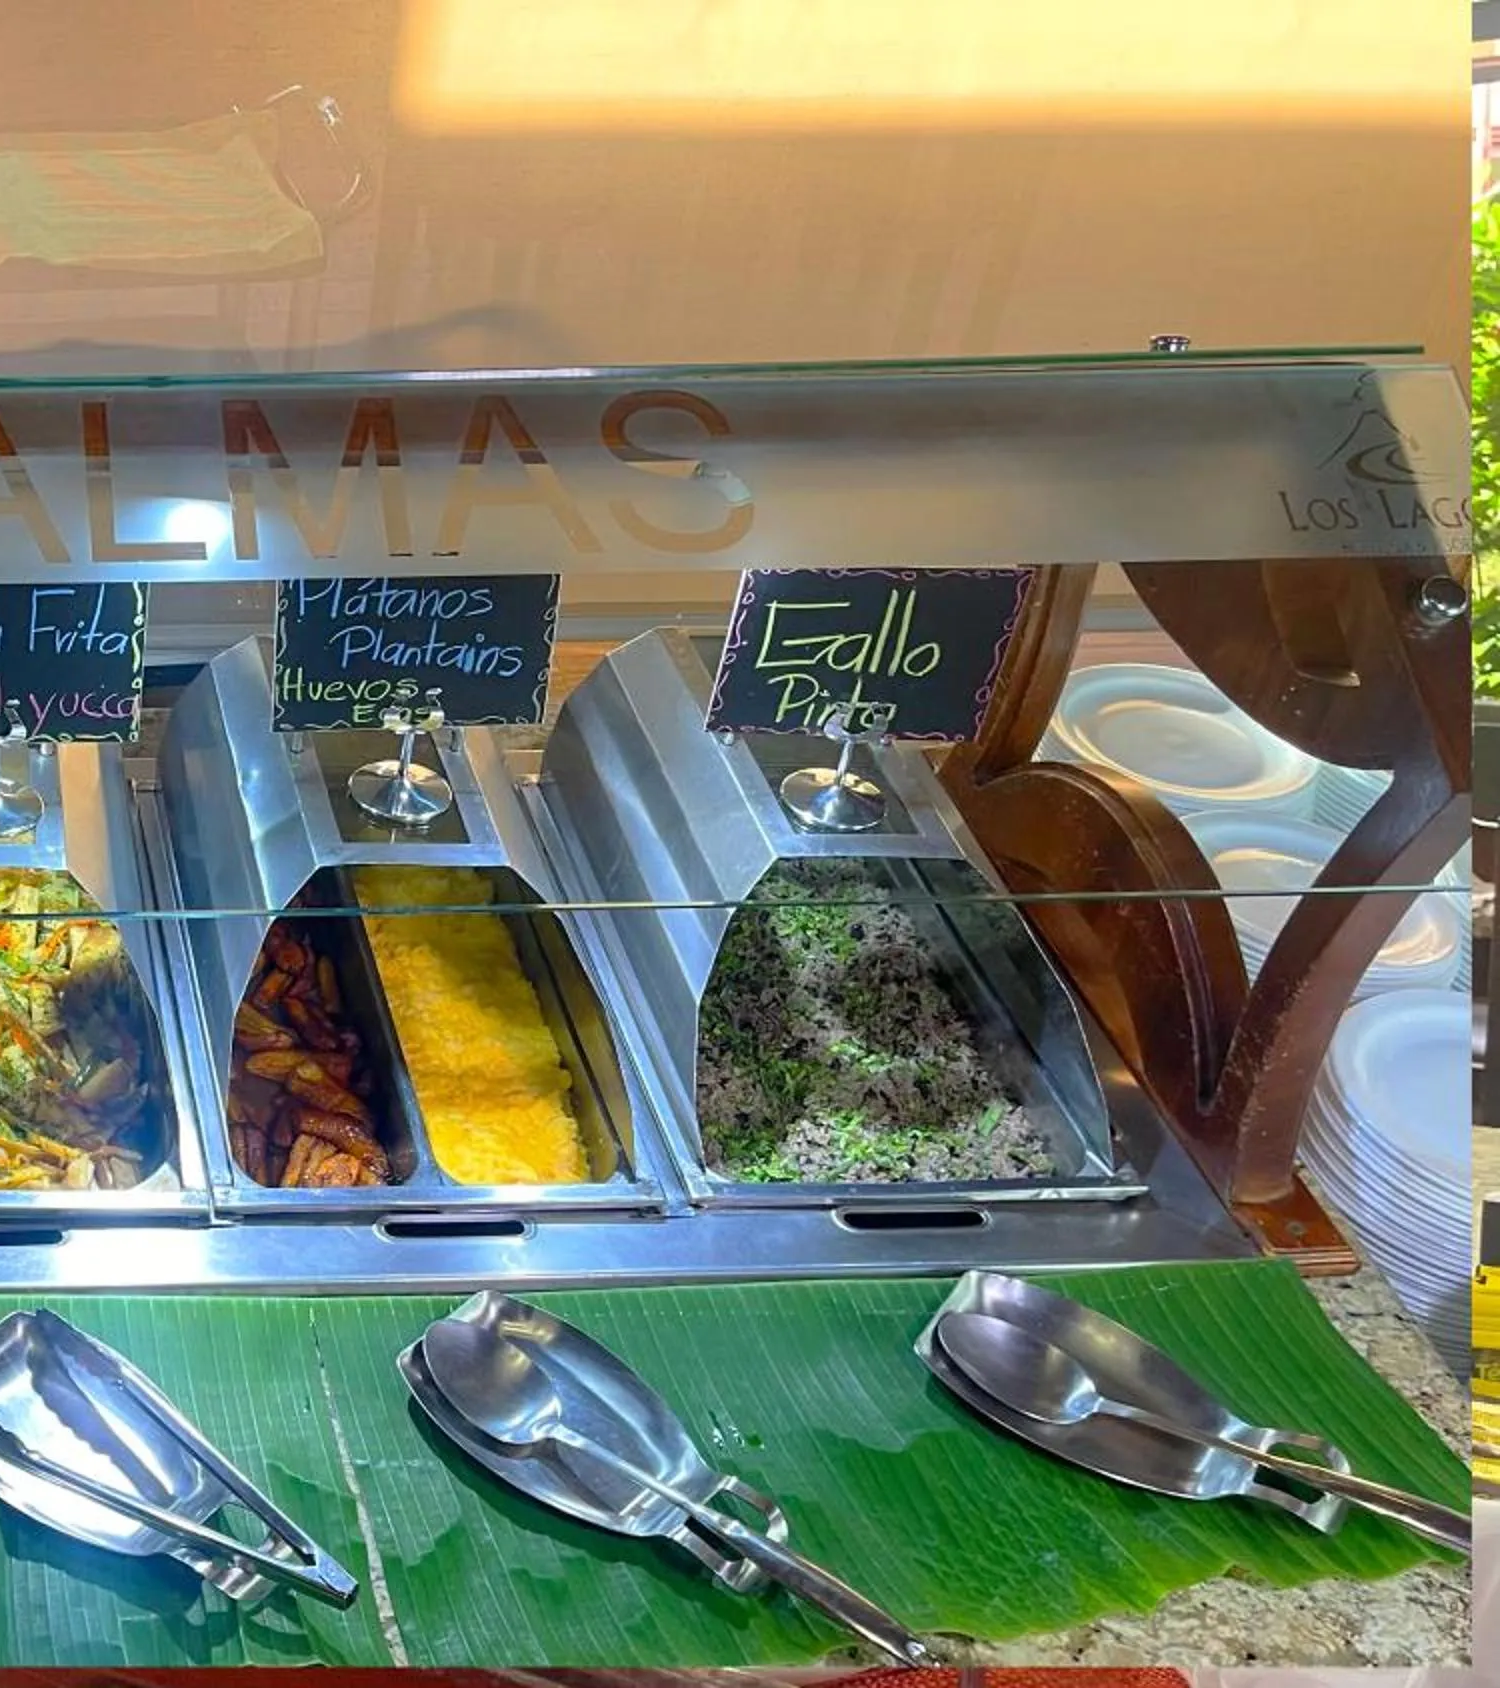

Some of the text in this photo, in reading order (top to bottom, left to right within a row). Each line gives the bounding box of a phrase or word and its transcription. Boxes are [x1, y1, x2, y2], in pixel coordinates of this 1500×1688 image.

[1279, 491, 1359, 532] LOS
[29, 584, 130, 653] Frita
[289, 577, 494, 621] Plátanos
[328, 620, 523, 678] Plantains
[755, 587, 941, 677] Gallo
[282, 667, 420, 702] Huevos
